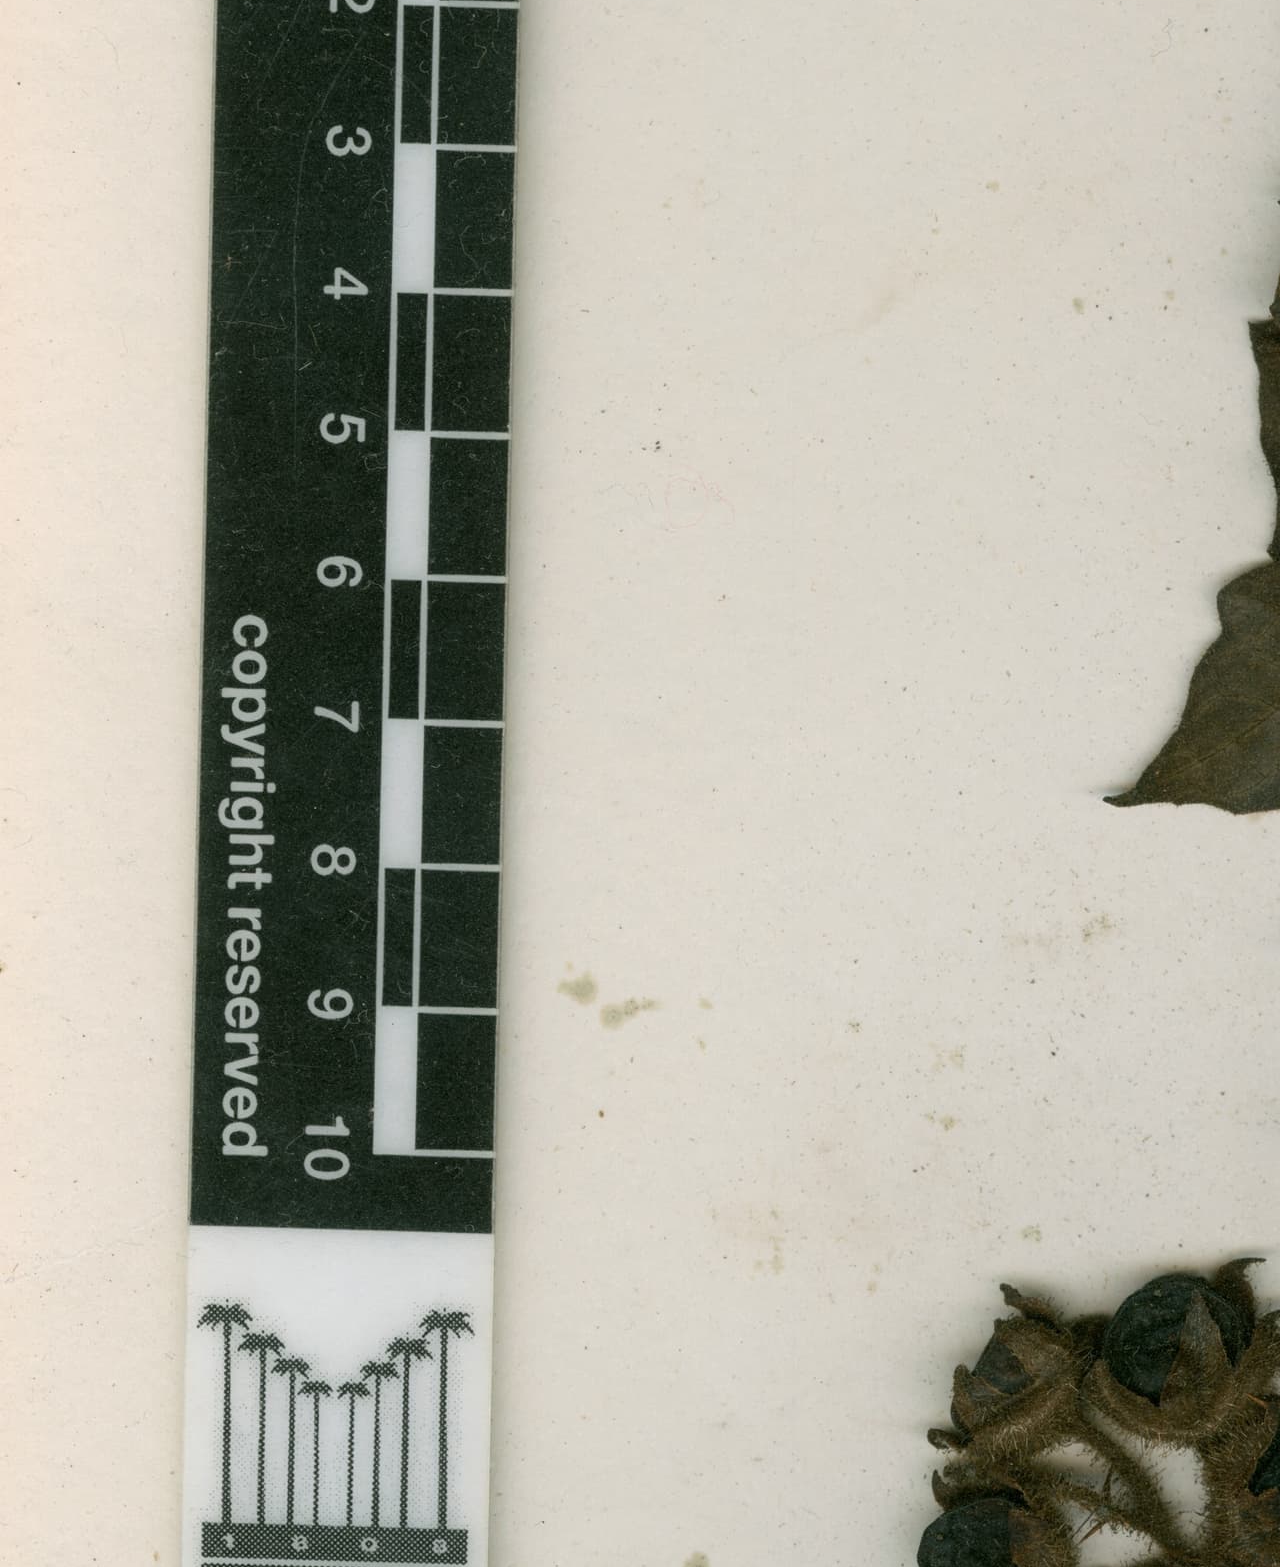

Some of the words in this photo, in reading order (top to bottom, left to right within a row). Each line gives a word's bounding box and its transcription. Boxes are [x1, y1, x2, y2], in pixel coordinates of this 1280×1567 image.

[326, 125, 372, 156] 3
[323, 267, 368, 300] 4
[320, 413, 365, 444] 5
[317, 556, 363, 587] 6
[314, 701, 359, 732] 7
[218, 615, 276, 890] copyright
[310, 844, 356, 876] 8
[307, 989, 353, 1019] 9
[222, 908, 268, 1156] reserved
[304, 1116, 350, 1180] 10
